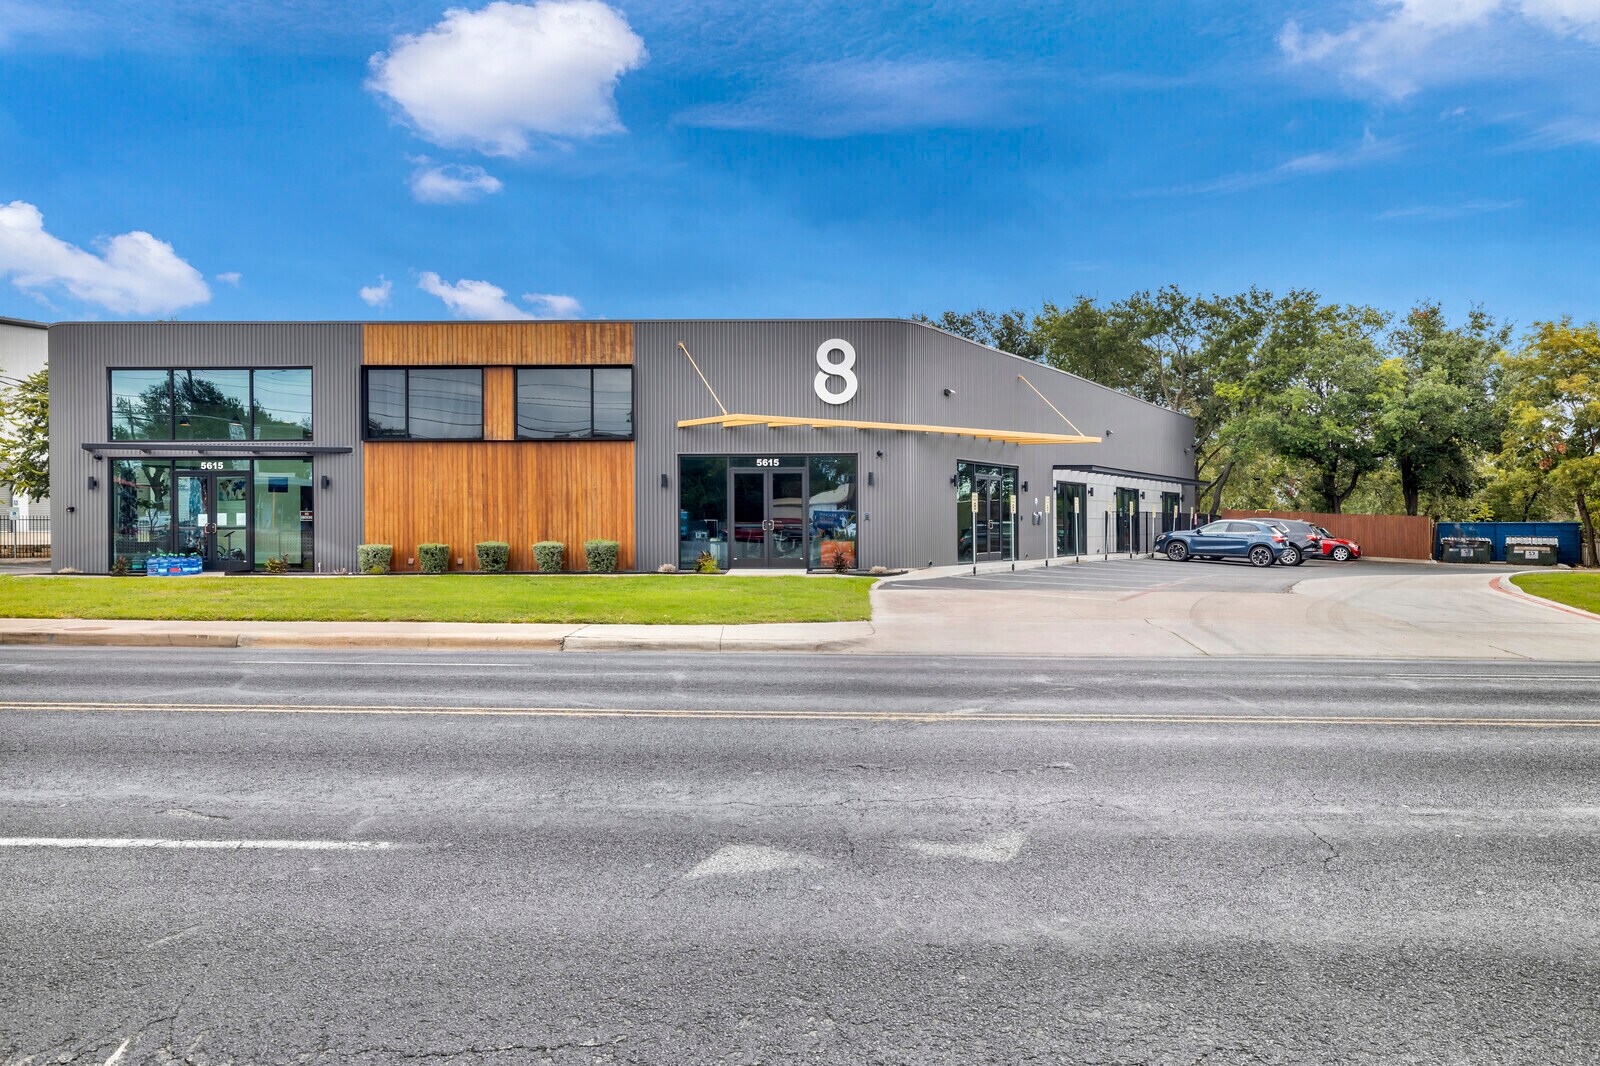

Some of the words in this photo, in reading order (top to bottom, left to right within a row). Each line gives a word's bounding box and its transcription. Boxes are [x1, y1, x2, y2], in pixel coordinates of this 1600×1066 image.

[813, 338, 858, 405] 8
[200, 461, 224, 470] 5615
[756, 458, 780, 467] 5615
